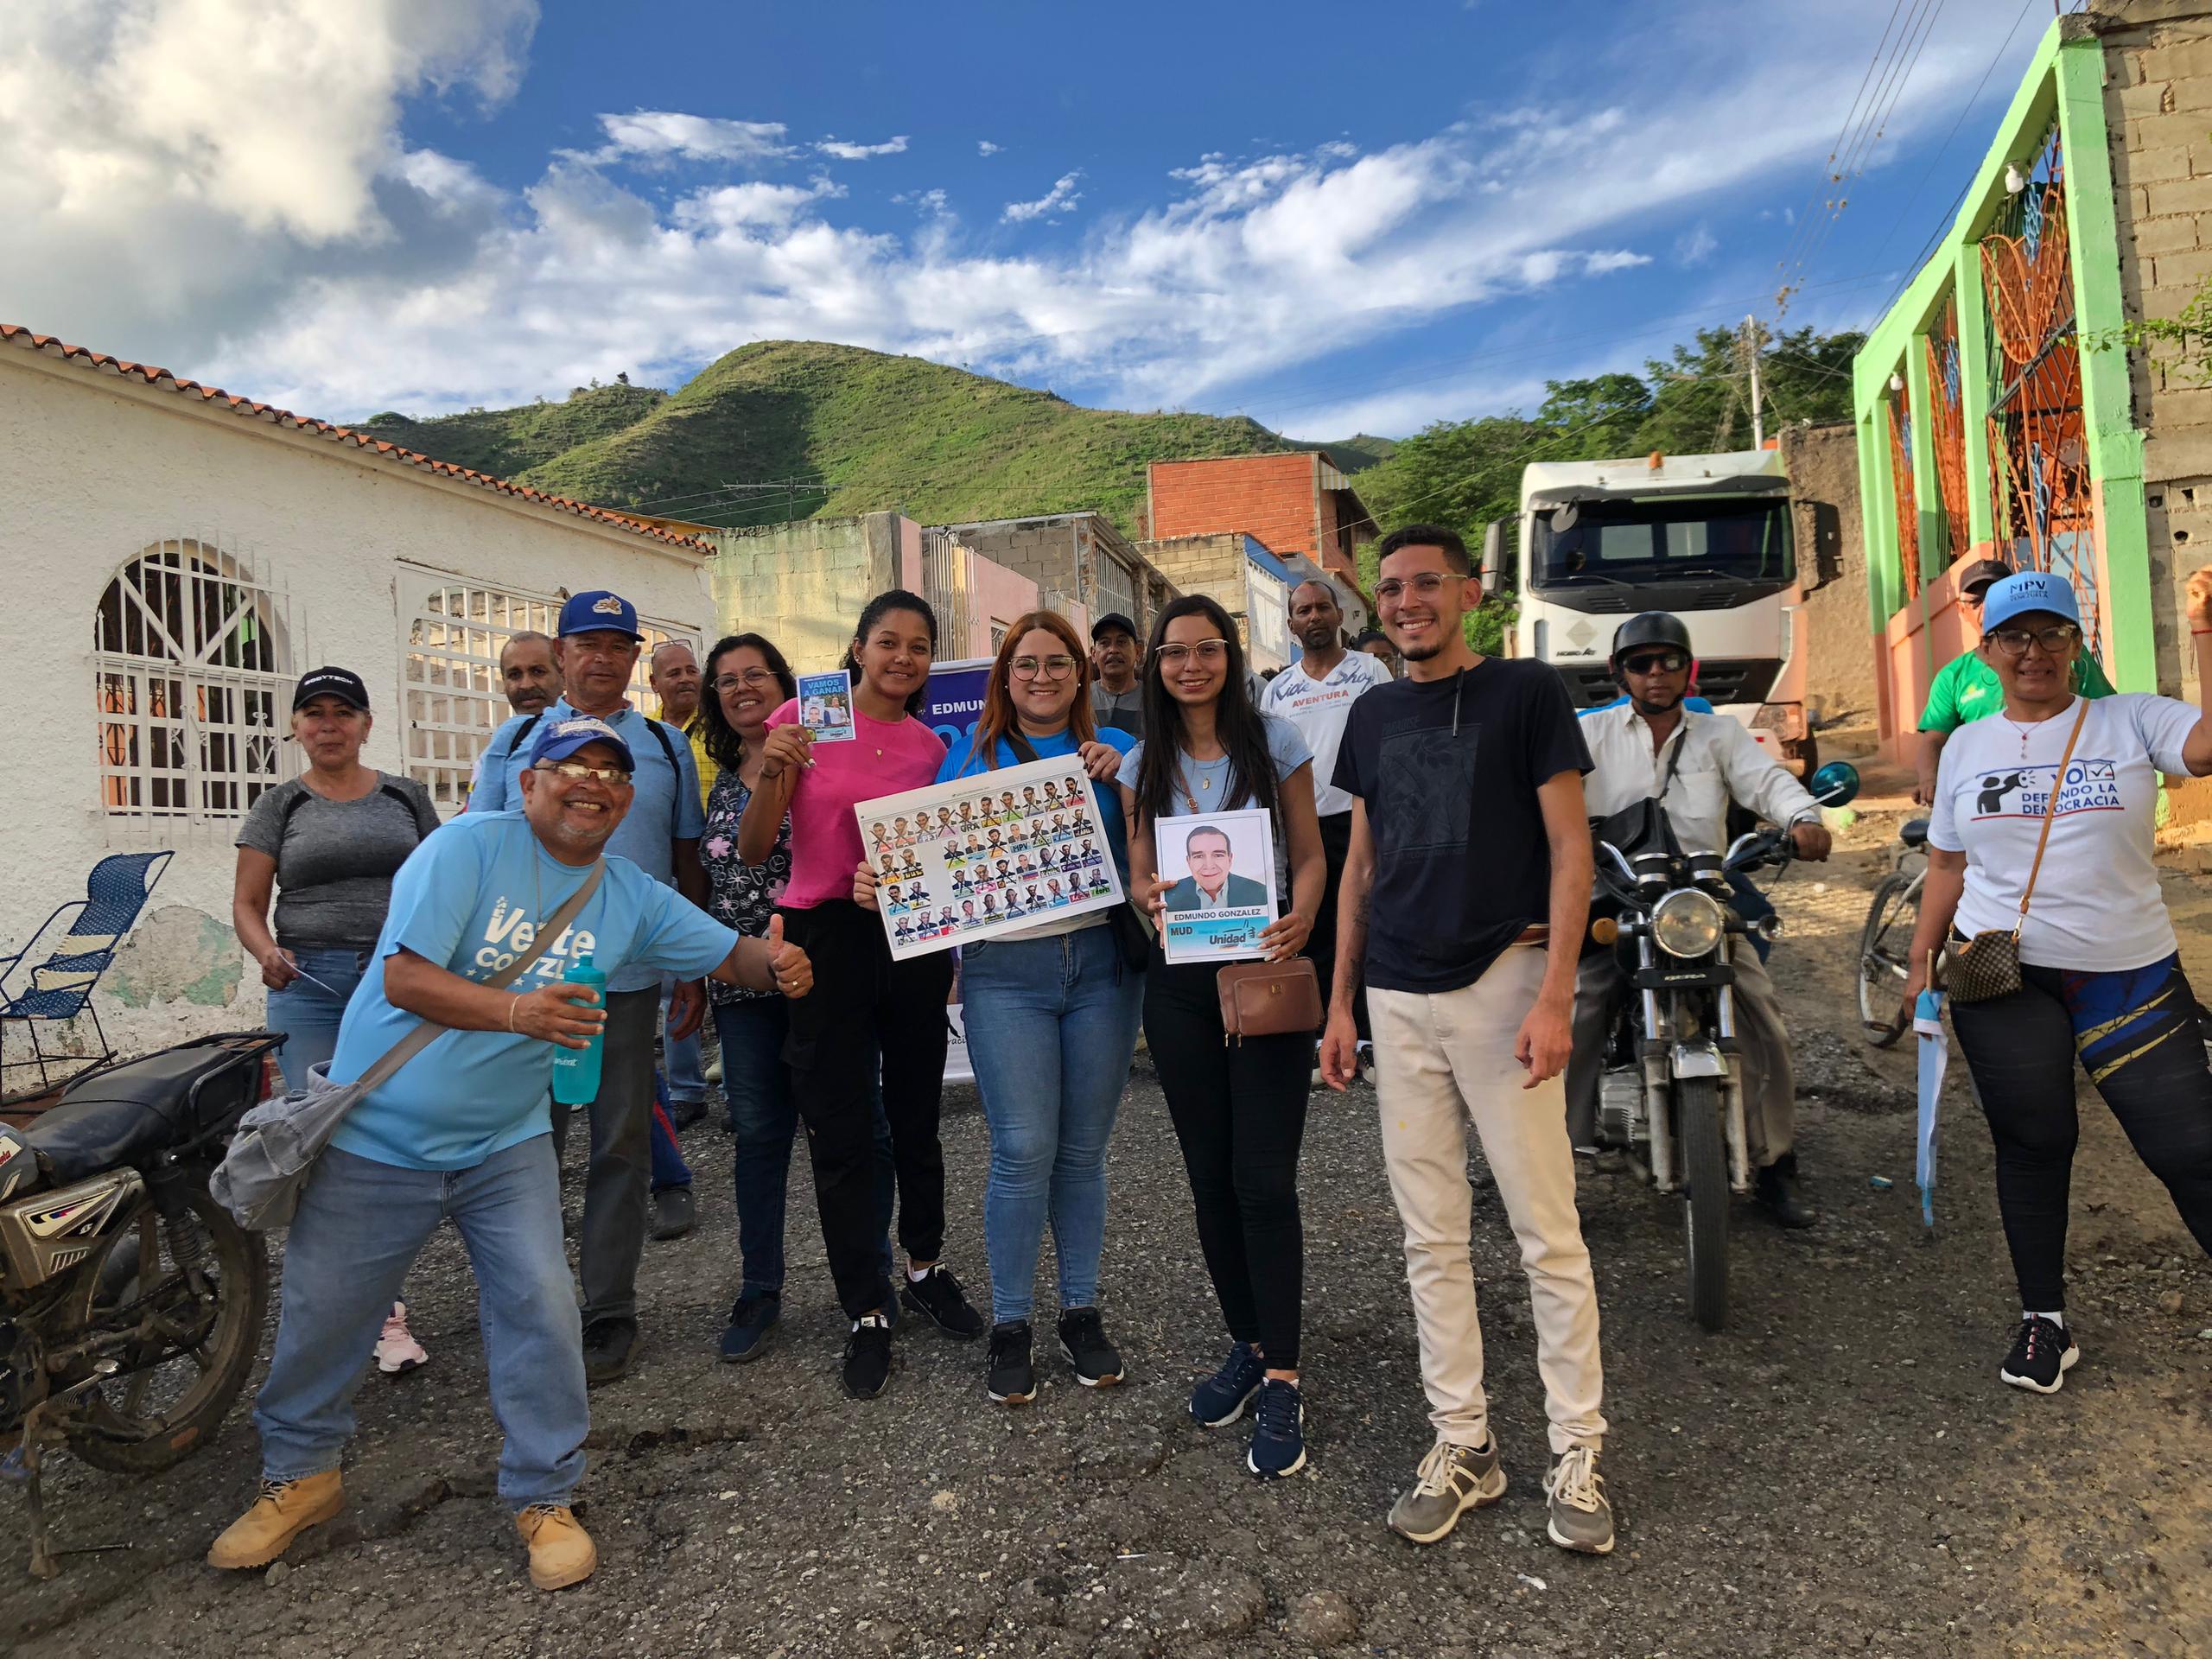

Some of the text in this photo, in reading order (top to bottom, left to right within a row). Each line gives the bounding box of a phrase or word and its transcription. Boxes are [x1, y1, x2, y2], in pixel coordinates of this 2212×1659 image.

[807, 679, 840, 690] VAMOS
[813, 685, 845, 696] GANAR
[1292, 690, 1349, 708] AVENTURA
[2051, 767, 2083, 785] O
[2099, 783, 2118, 793] LA
[2023, 796, 2120, 815] DEMOCRACIA
[1013, 842, 1028, 853] MPV
[1174, 908, 1262, 921] EDMUNDO GONZALEZ
[1170, 926, 1193, 936] MUD
[1210, 933, 1246, 945] Unidad
